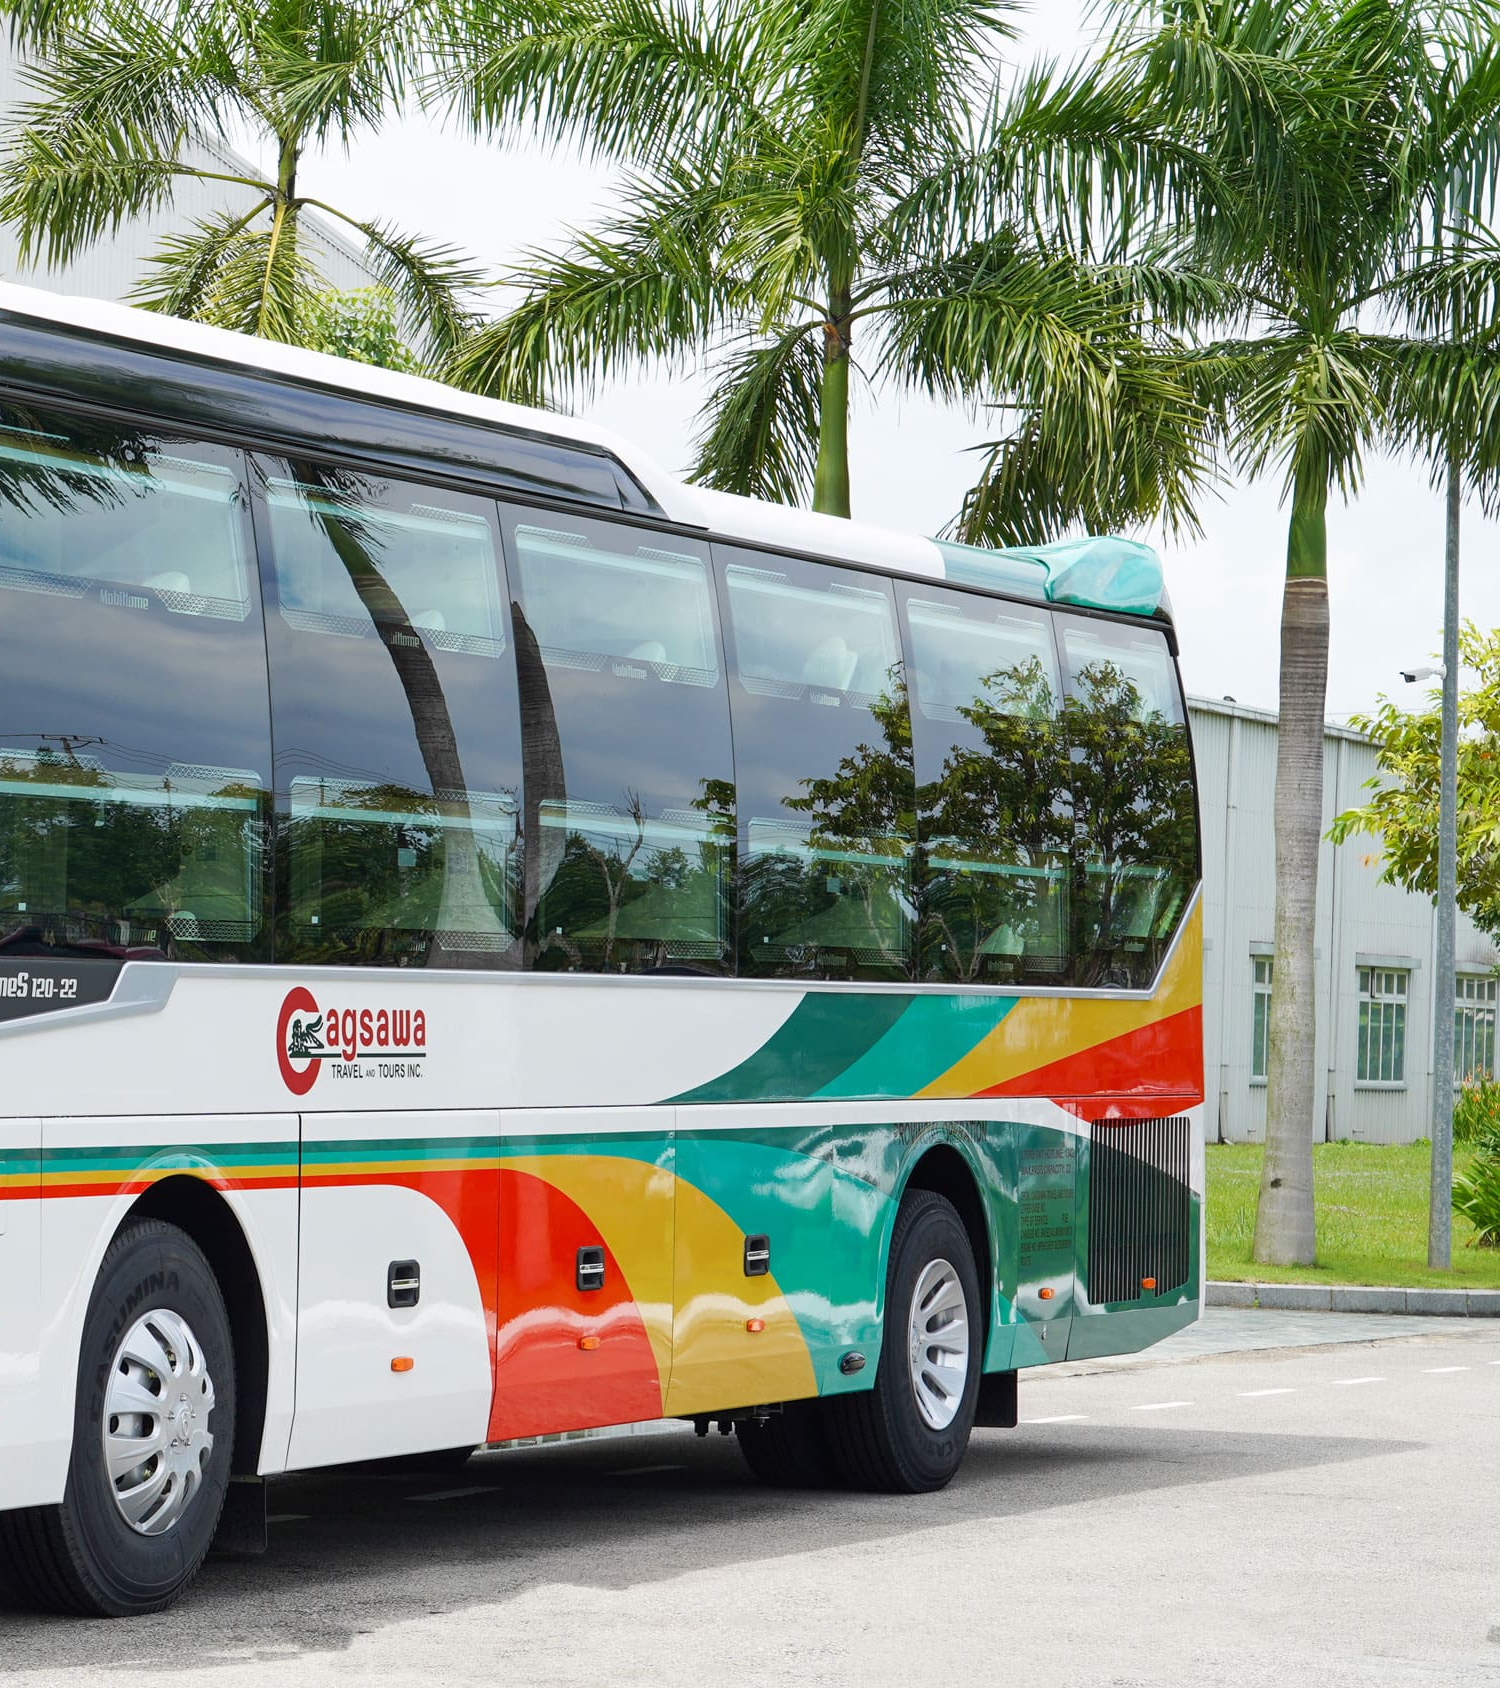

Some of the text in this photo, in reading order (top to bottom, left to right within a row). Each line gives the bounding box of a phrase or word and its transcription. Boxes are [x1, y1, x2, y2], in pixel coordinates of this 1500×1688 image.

[100, 588, 149, 610] MobiHome
[31, 978, 78, 999] 120-22
[331, 1063, 423, 1079] TRAVEL AND TOURS INC.
